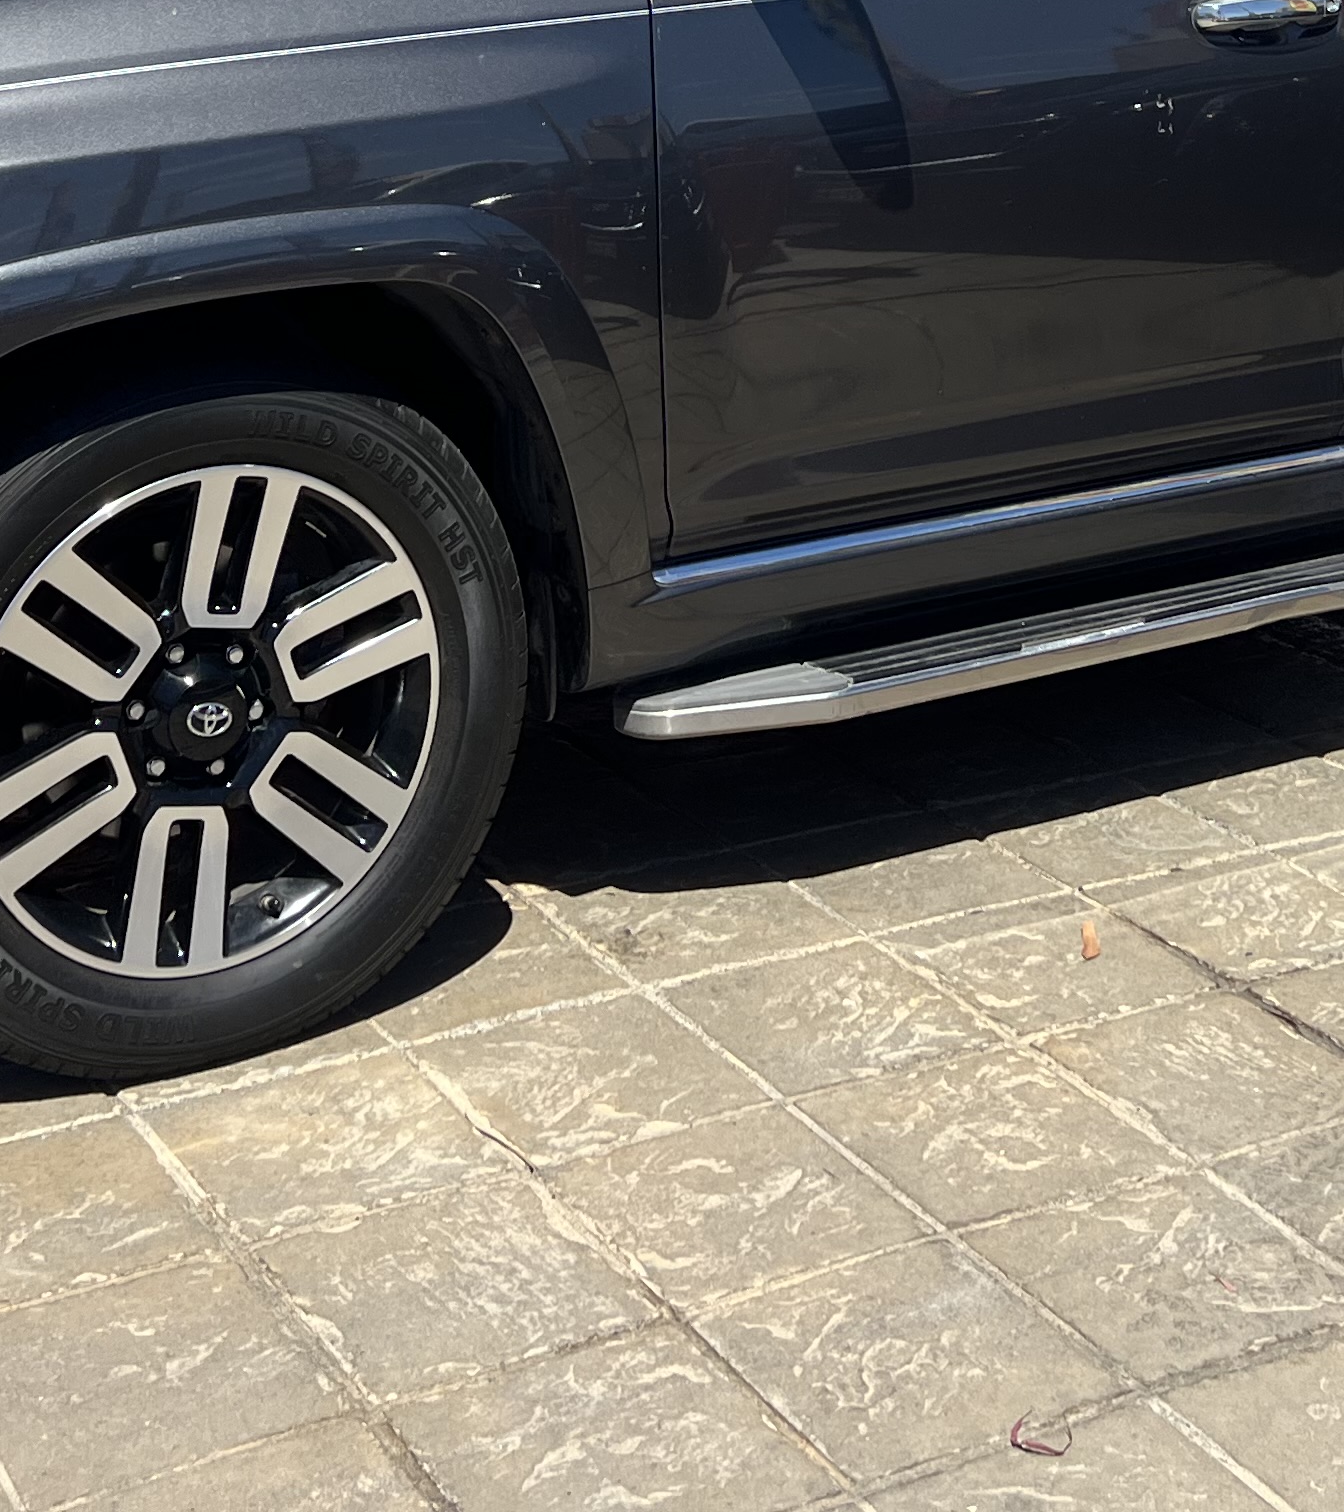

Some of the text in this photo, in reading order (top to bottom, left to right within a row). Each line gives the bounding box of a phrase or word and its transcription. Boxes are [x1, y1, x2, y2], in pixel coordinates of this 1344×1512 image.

[247, 409, 484, 585] WILD SPIRIT HST
